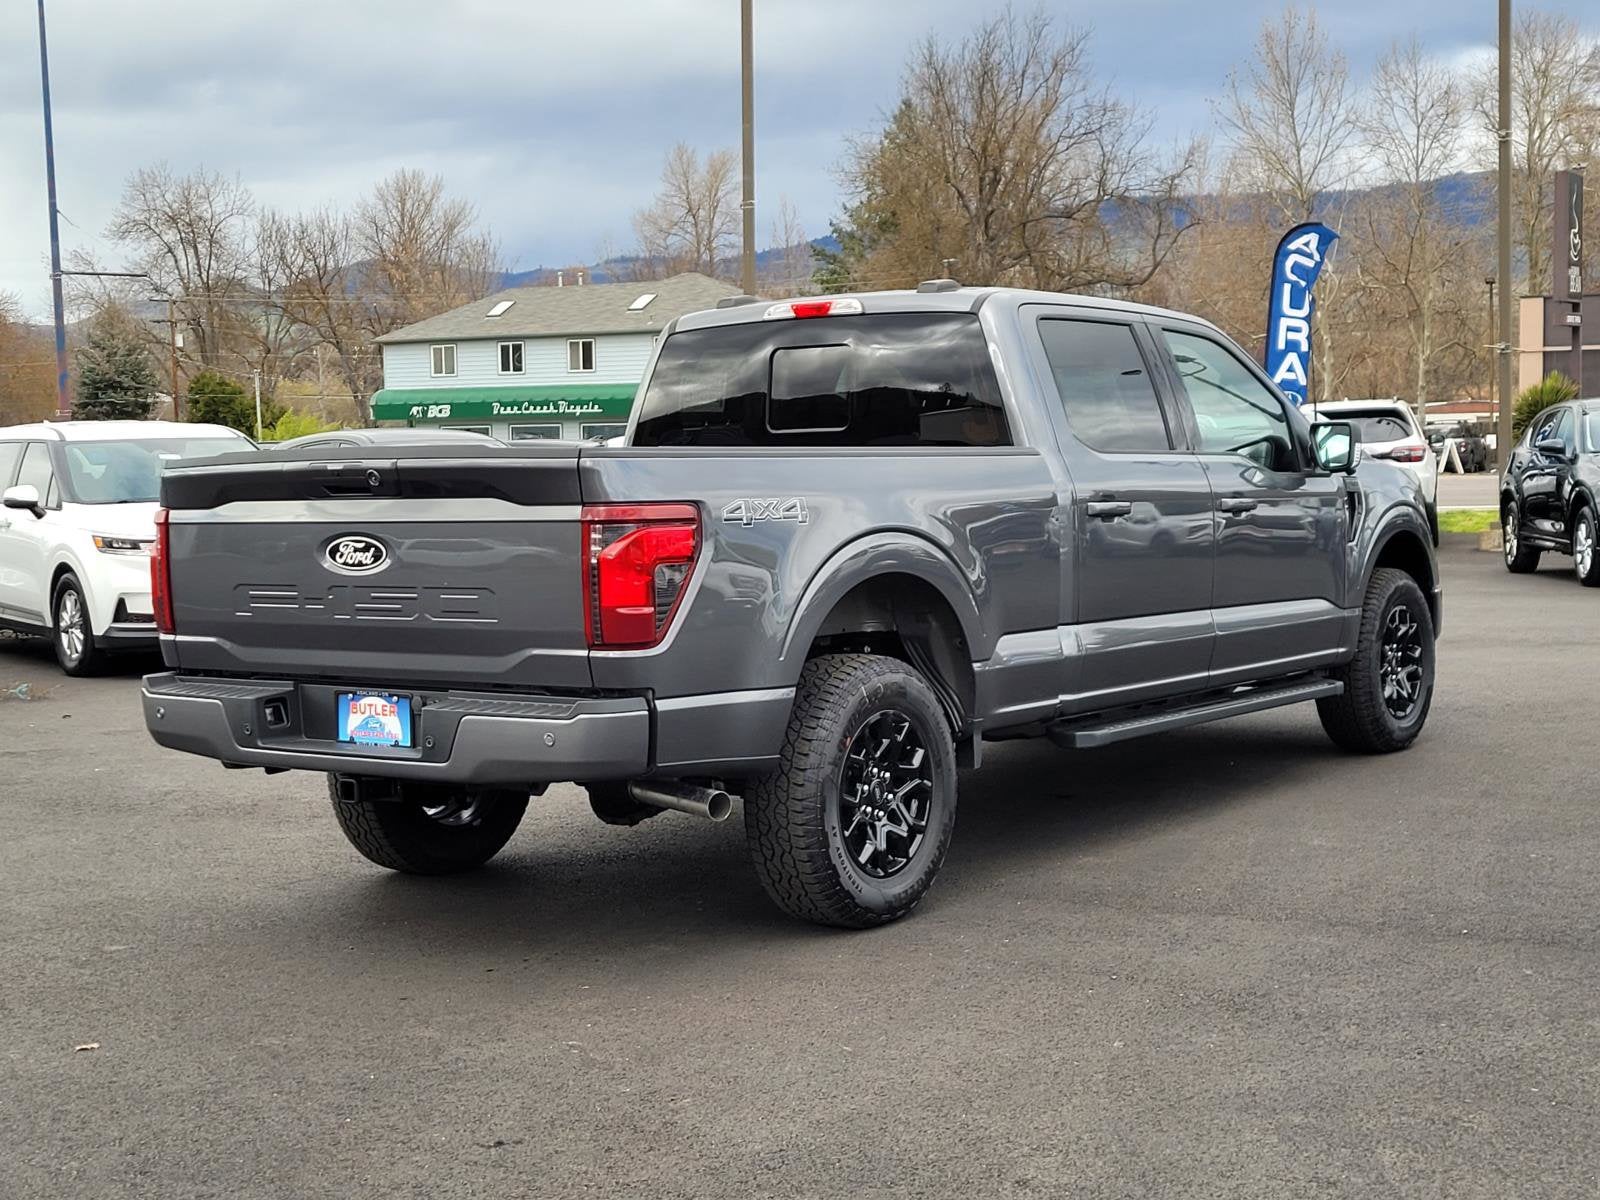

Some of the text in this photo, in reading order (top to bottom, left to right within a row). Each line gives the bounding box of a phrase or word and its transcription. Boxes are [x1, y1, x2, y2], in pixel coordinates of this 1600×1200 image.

[1273, 232, 1321, 386] ACURA
[558, 401, 603, 416] Bicycle
[335, 541, 376, 565] Ford
[233, 584, 499, 623] F-150
[351, 702, 397, 717] BUTLER
